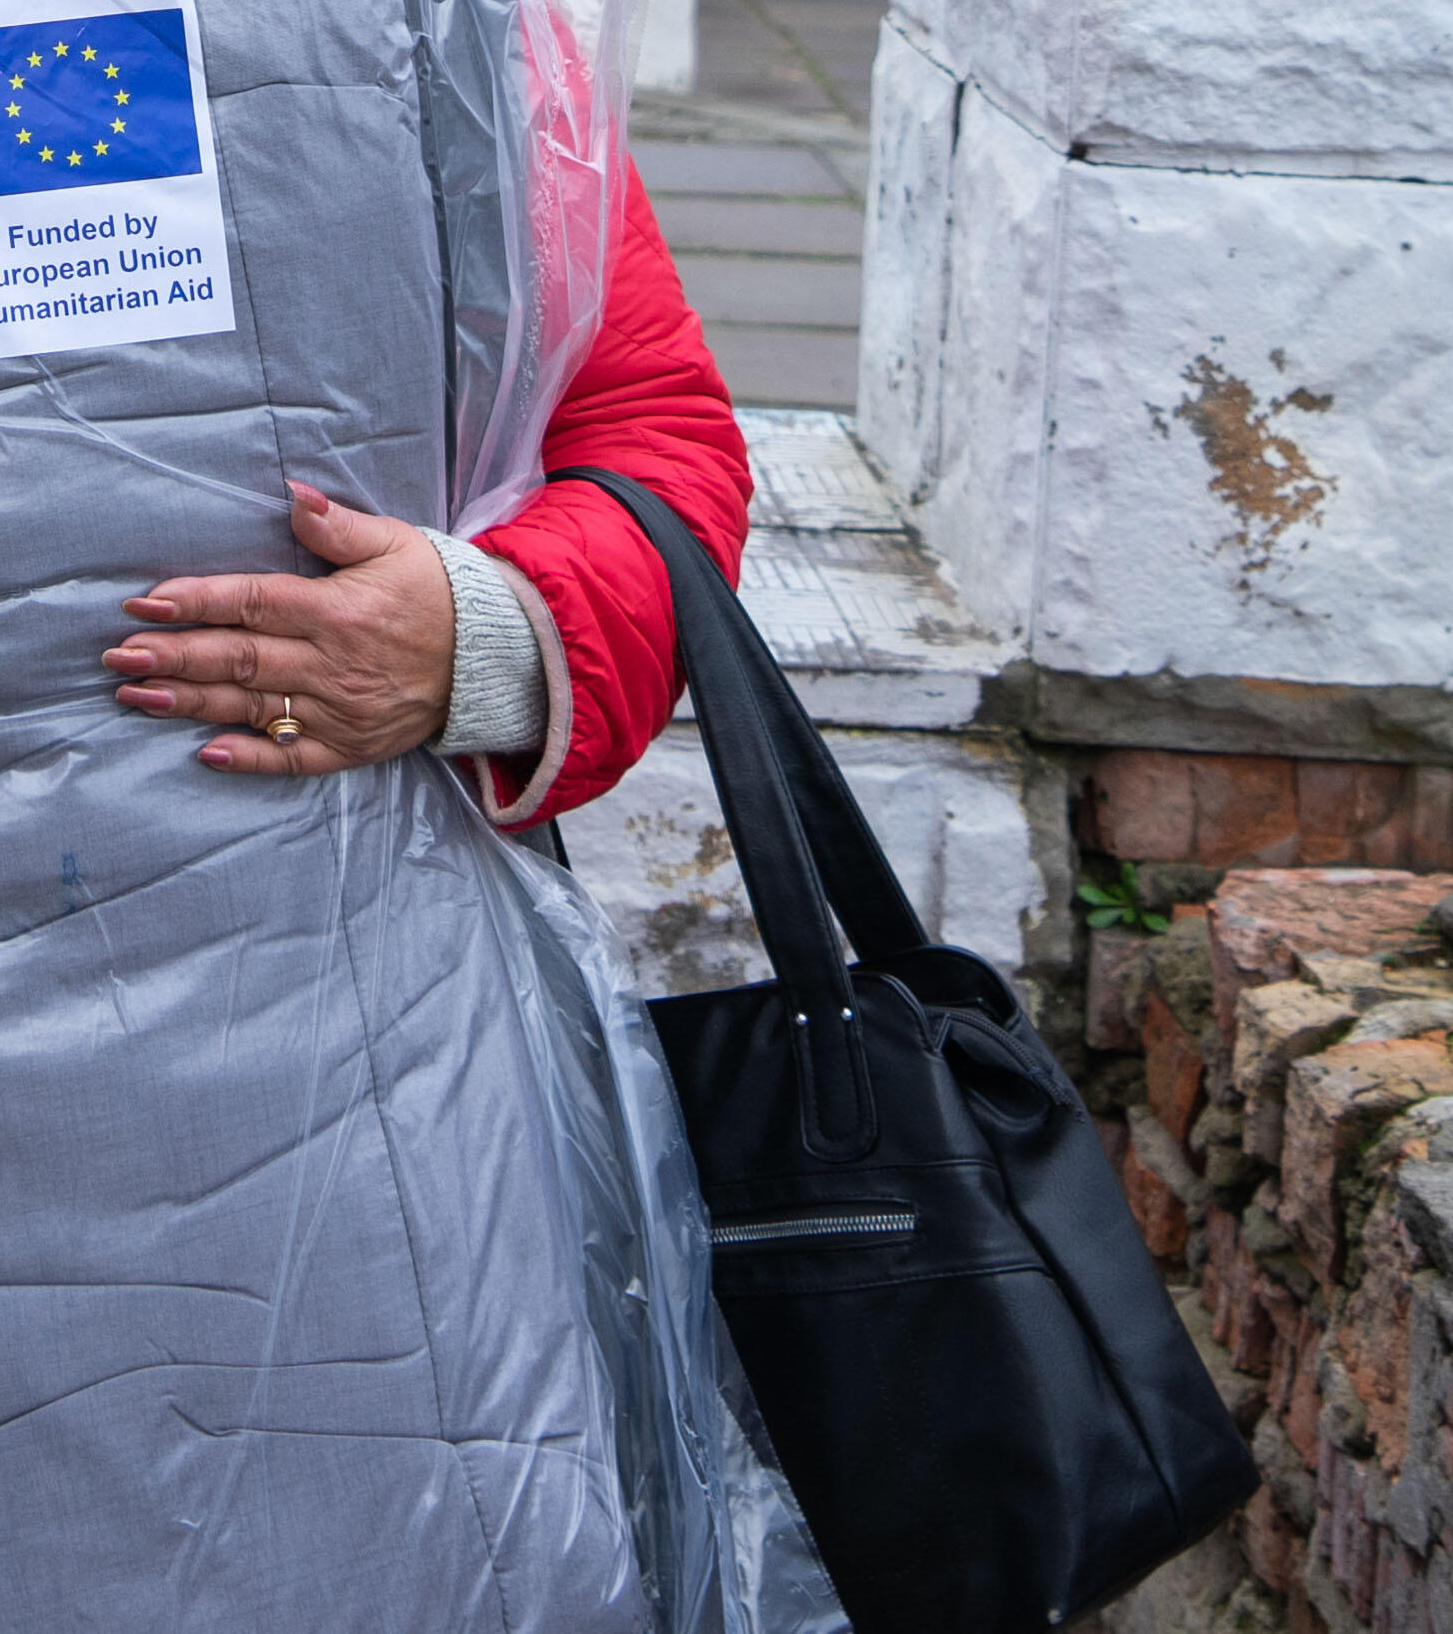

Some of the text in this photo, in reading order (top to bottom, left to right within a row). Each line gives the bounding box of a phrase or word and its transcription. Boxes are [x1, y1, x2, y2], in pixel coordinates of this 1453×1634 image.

[8, 212, 158, 249] Funded by
[118, 245, 203, 274] Union
[167, 276, 214, 305] Aid
